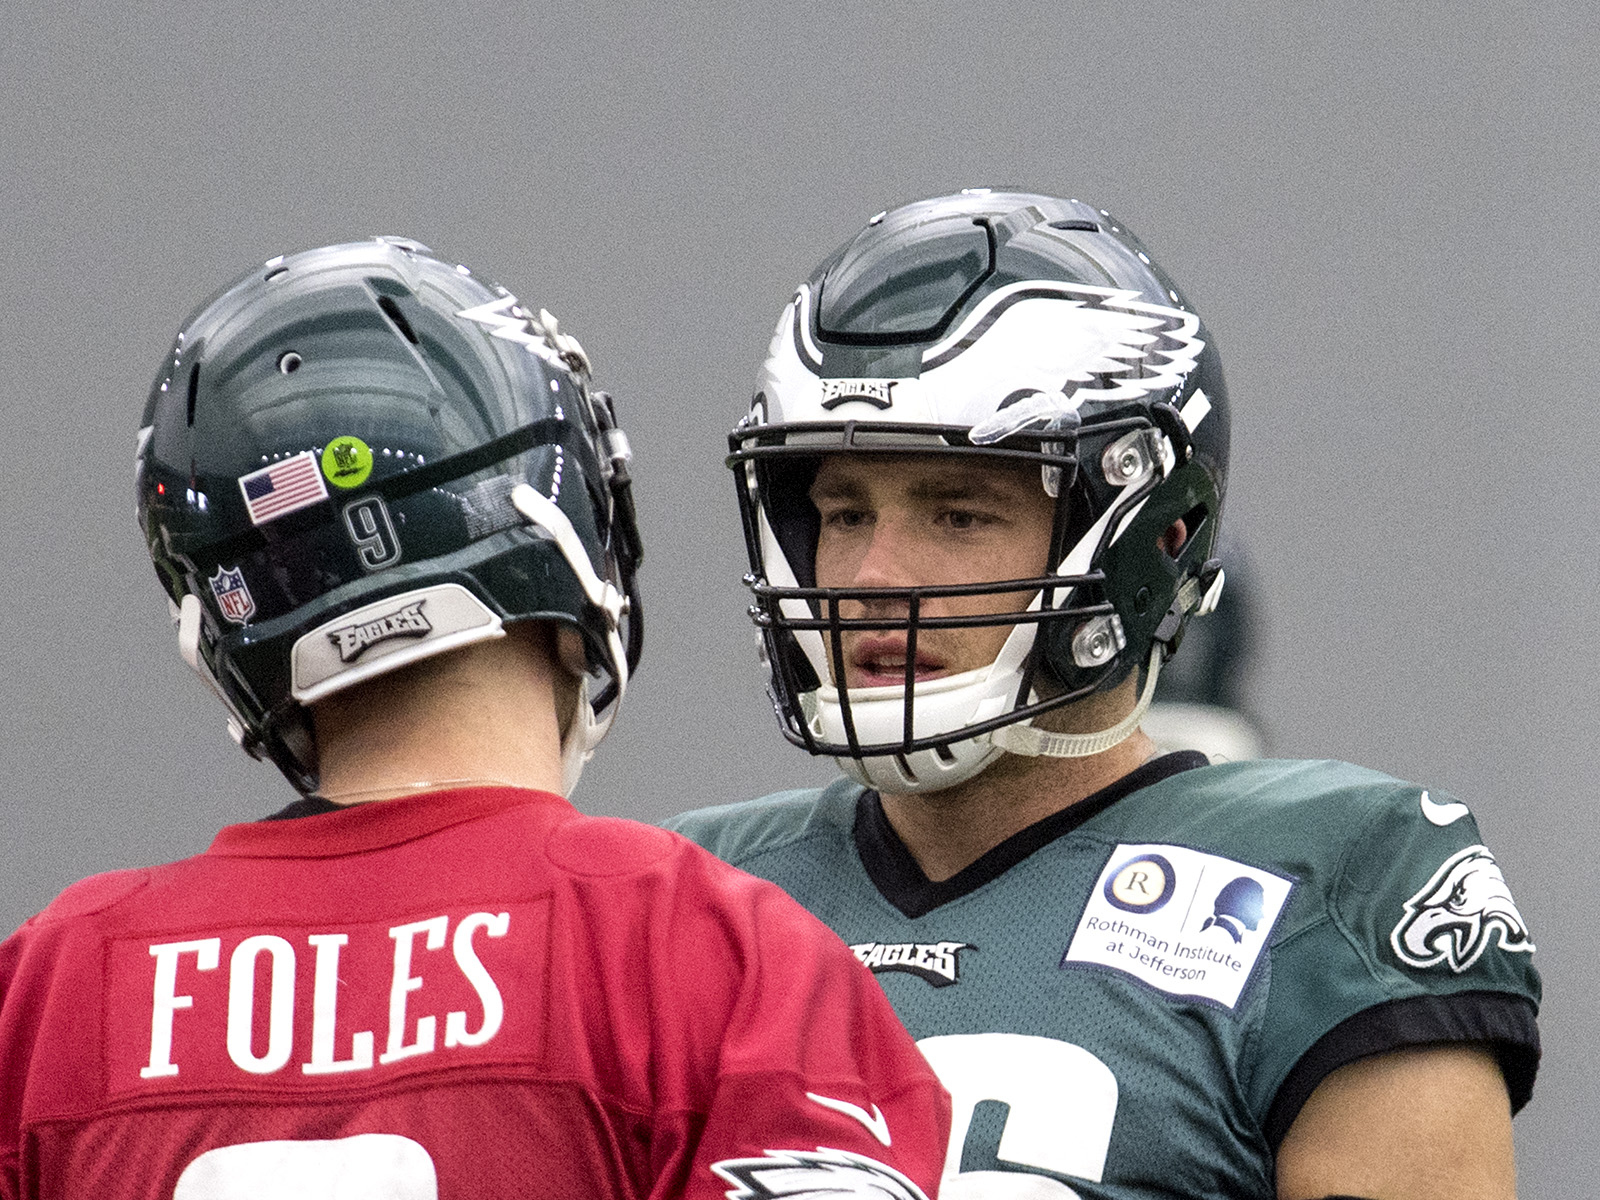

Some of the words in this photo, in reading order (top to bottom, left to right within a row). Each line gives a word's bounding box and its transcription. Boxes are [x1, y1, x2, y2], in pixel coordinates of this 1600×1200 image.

[821, 380, 893, 409] EAGLES
[343, 496, 401, 570] 9
[220, 589, 250, 616] NFL
[330, 600, 432, 661] EAGLES
[1125, 871, 1150, 895] R
[1086, 916, 1169, 953] Rothman
[1173, 942, 1242, 972] Institute
[1105, 941, 1123, 955] at
[1129, 946, 1206, 981] Jefferson
[140, 912, 510, 1078] FOLES
